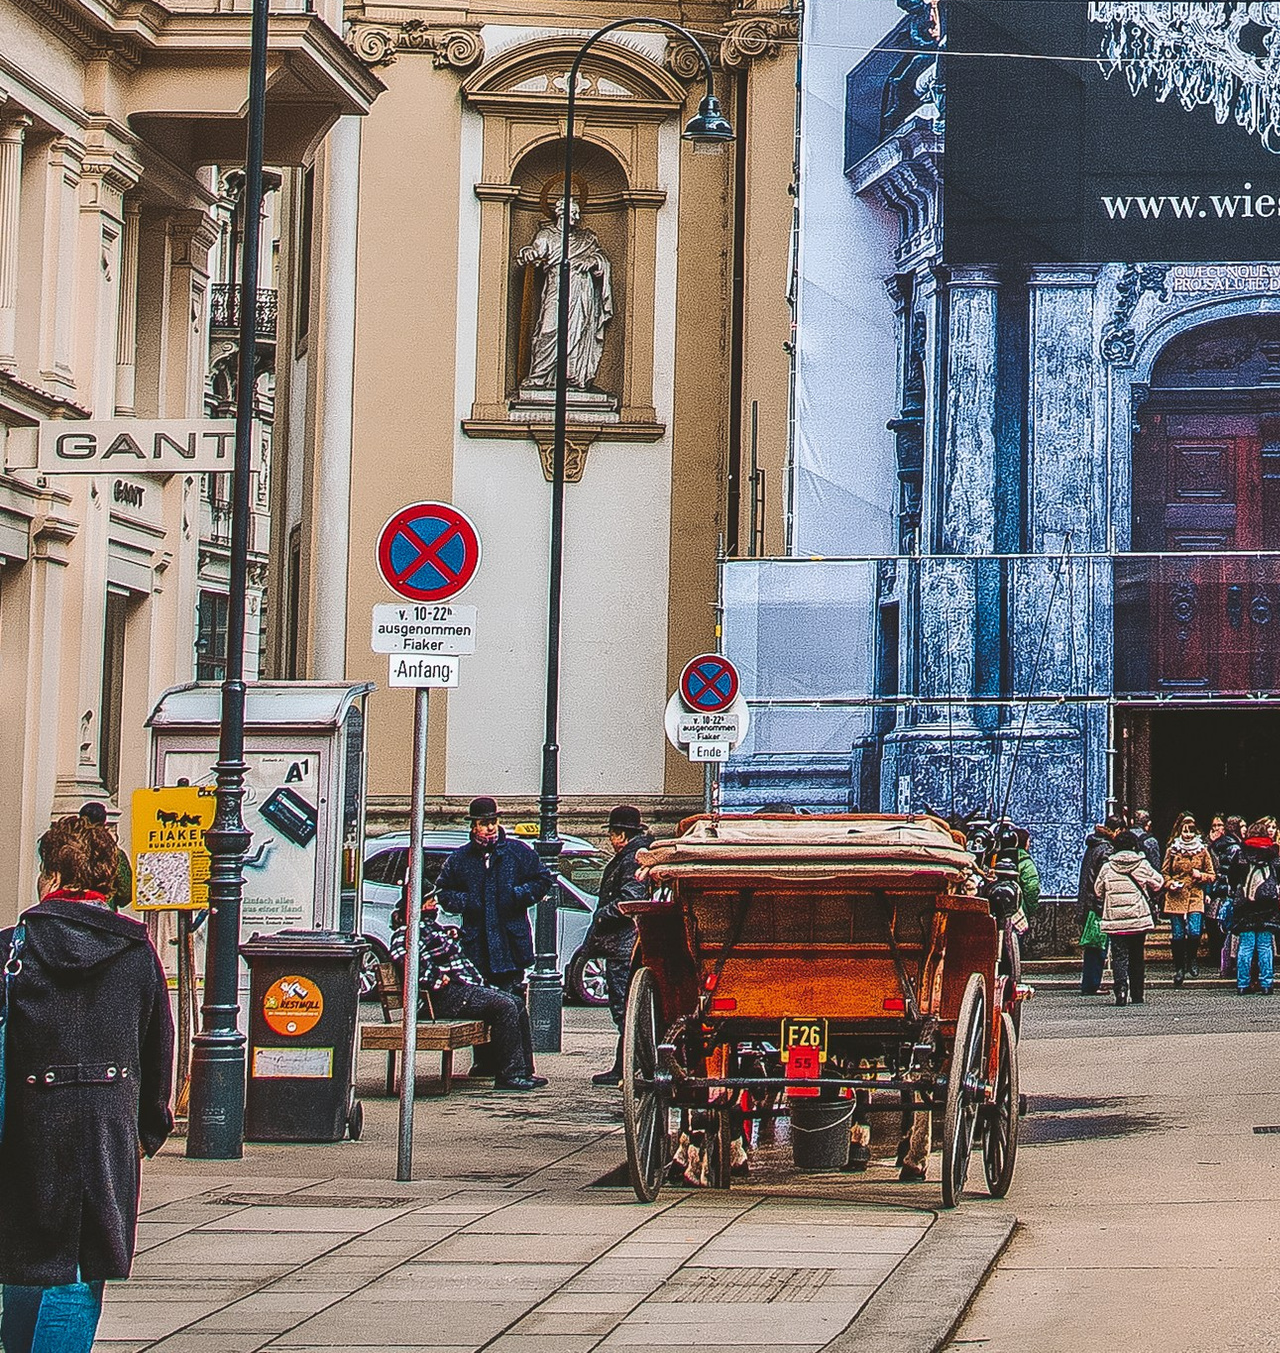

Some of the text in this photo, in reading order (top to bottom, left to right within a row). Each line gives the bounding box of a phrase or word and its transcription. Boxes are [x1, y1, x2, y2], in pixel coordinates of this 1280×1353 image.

[56, 433, 236, 459] GANT
[114, 479, 145, 509] GANT
[398, 609, 409, 621] v.
[378, 625, 471, 637] ausgenommen
[403, 639, 444, 651] Fiaker
[397, 660, 450, 682] Anfang
[682, 725, 736, 733] ausgenommen
[697, 746, 722, 757] Ende
[285, 759, 309, 783] A1
[148, 841, 204, 849] RUNDFAHRTE
[243, 896, 294, 905] Einfach alles
[258, 905, 279, 913] einer
[789, 1025, 820, 1046] F26
[795, 1057, 812, 1069] 55
